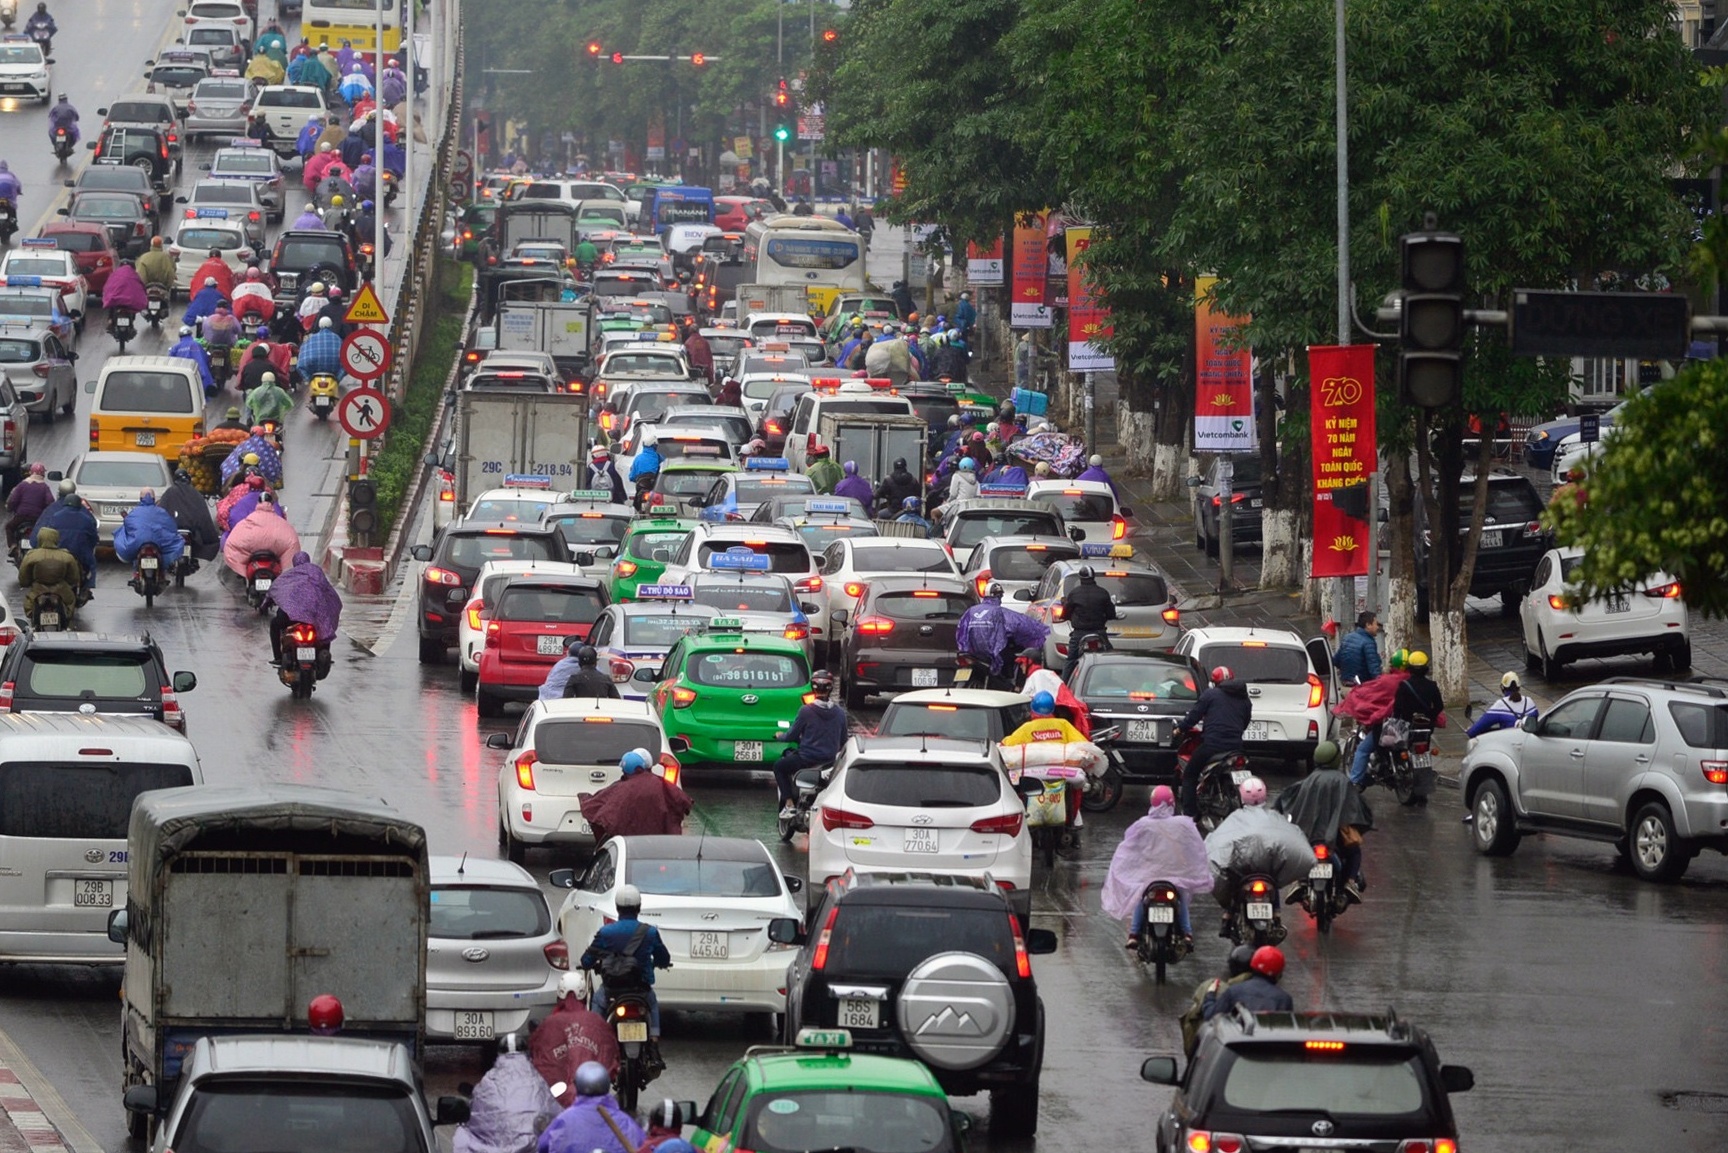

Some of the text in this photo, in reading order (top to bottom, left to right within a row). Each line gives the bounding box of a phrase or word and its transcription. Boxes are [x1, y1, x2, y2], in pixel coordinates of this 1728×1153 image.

[1013, 311, 1049, 319] Vietcombank
[1325, 416, 1358, 431] KỶ NIỆM
[1197, 430, 1249, 439] Vietcombank
[1327, 434, 1338, 444] 70
[1332, 446, 1353, 457] NGÀY
[482, 462, 502, 474] 29C
[1321, 459, 1363, 472] TOÀN QUỐC
[1317, 477, 1343, 488] KHÁNG
[675, 587, 690, 595] SAO
[543, 636, 559, 645] 29A
[538, 645, 563, 654] 489.29
[727, 671, 740, 680] 38
[743, 671, 754, 680] 61
[758, 671, 769, 681] 61
[1134, 722, 1150, 731] 29A
[1128, 731, 1156, 740] 950.44
[740, 741, 756, 750] 30A
[735, 751, 762, 760] 256.81
[912, 829, 931, 840] 30A
[905, 840, 937, 850] 770.64
[84, 881, 104, 893] 29B
[76, 893, 111, 905] 008.33
[699, 932, 720, 944] 29A
[692, 945, 727, 957] 445.40
[846, 1000, 871, 1012] 56S
[464, 1012, 485, 1025] 30A
[844, 1012, 873, 1026] 1684
[456, 1025, 492, 1038] 893.60
[809, 1032, 842, 1044] TAXI
